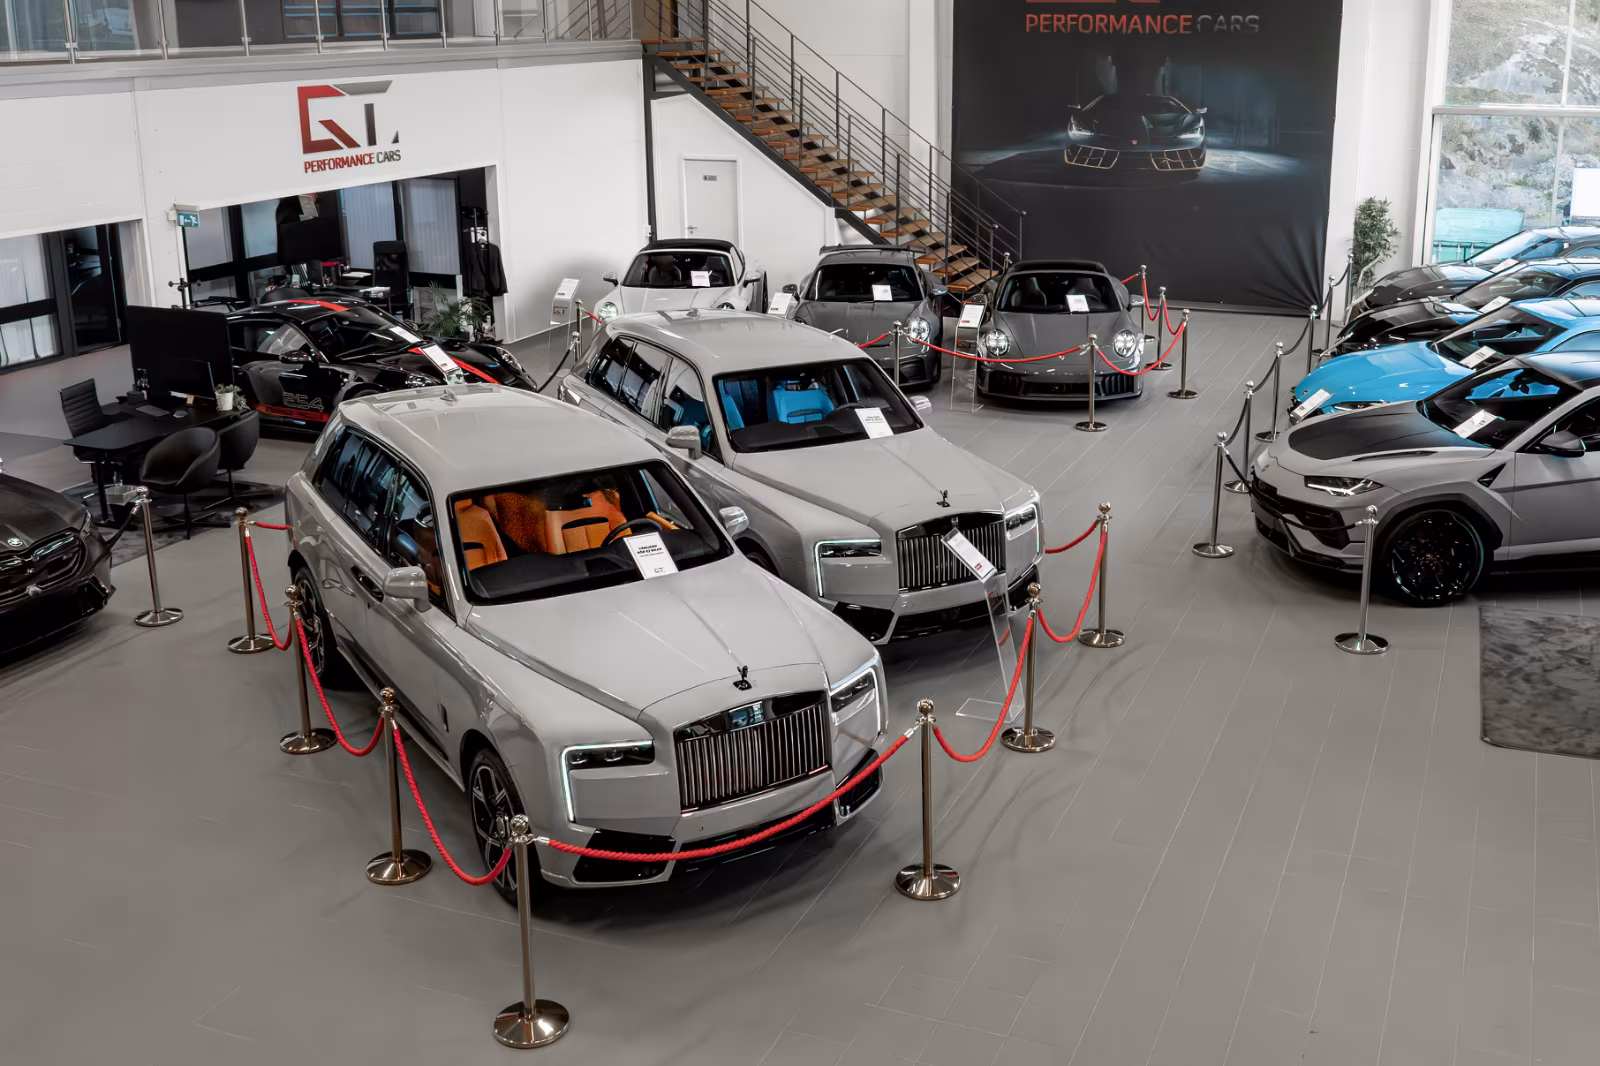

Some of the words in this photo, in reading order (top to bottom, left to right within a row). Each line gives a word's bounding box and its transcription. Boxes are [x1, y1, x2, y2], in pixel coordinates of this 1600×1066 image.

[1025, 13, 1193, 34] PERFORMANCE
[1196, 14, 1260, 34] CARS
[303, 152, 375, 174] PERFORMANCE
[376, 149, 402, 164] CARS
